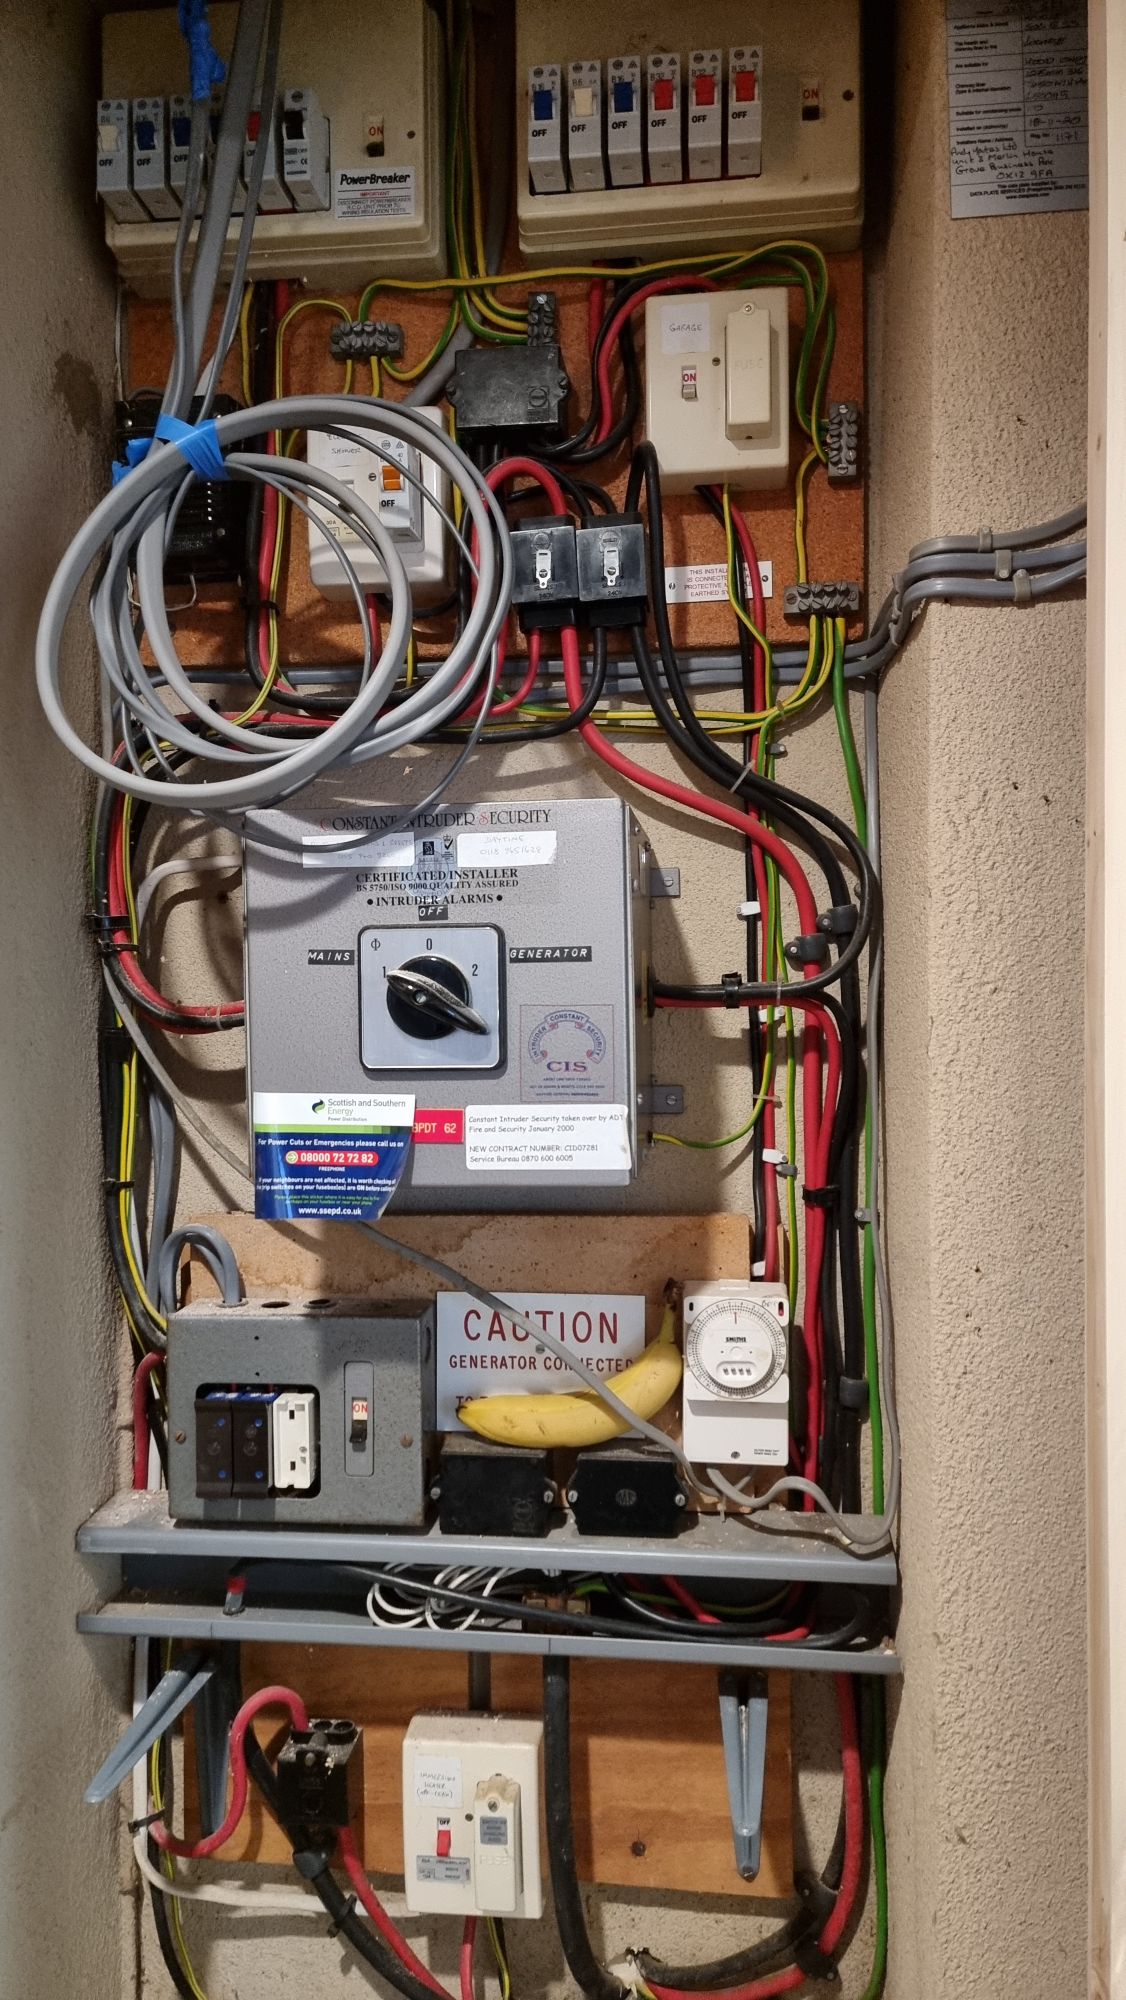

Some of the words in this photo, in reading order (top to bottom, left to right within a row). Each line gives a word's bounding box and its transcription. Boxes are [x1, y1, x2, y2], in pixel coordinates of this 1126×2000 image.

[803, 88, 820, 99] ON
[691, 115, 708, 124] OFF
[732, 111, 748, 120] OFF
[571, 124, 587, 133] OFF
[611, 121, 628, 130] OFF
[651, 119, 667, 128] OFF
[369, 125, 384, 136] ON
[532, 129, 548, 138] OFF
[99, 158, 114, 167] OFF
[136, 158, 152, 167] OFF
[173, 153, 188, 163] OFF
[340, 172, 412, 186] PowerBreaker
[669, 323, 703, 332] GARAGE
[682, 372, 697, 383] ON
[381, 499, 396, 508] OFF
[320, 815, 398, 831] CONSTANT
[403, 811, 476, 829] NTRUDER
[478, 808, 552, 826] SECURITY
[356, 870, 447, 883] CERTIFICATED
[449, 868, 519, 881] INSTALLER
[356, 884, 367, 892] BS
[408, 881, 428, 891] 9000
[430, 880, 472, 891] QUALITY
[473, 879, 519, 889] ASSURED
[376, 895, 440, 906] INTRUDER
[443, 893, 494, 905] ALARMS
[419, 906, 443, 917] OFF
[426, 937, 433, 951] 0
[308, 951, 351, 962] MAINS
[509, 947, 588, 960] GENERATOR
[382, 965, 387, 978] 1
[471, 964, 479, 977] 2
[549, 1013, 585, 1022] CONSTANT
[546, 1060, 589, 1073] CIS
[327, 1098, 357, 1107] Scottish
[358, 1099, 371, 1107] and
[372, 1099, 406, 1107] Southern
[327, 1107, 354, 1116] Energy
[469, 1115, 498, 1123] Constant
[531, 1115, 561, 1124] Security
[598, 1114, 607, 1123] by
[444, 1122, 457, 1134] 62
[469, 1125, 483, 1133] Fire
[498, 1124, 526, 1134] Security
[528, 1124, 555, 1134] January
[557, 1124, 575, 1132] 2000
[268, 1138, 288, 1146] Power
[313, 1139, 355, 1148] Emergencies
[355, 1139, 377, 1148] please
[469, 1145, 487, 1153] NEW
[488, 1145, 528, 1153] CONTRACT
[300, 1152, 331, 1162] 08000
[333, 1152, 345, 1163] 72
[347, 1152, 359, 1163] 72
[361, 1152, 374, 1164] 82
[470, 1155, 495, 1163] Service
[496, 1154, 520, 1162] Bureau
[521, 1154, 539, 1162] 0870
[540, 1154, 554, 1162] 600
[556, 1154, 574, 1162] 6005
[298, 1206, 362, 1216] www.ssepd.co.uk
[463, 1309, 618, 1345] CAUTION
[449, 1354, 537, 1371] GENERATOR
[544, 1356, 634, 1374] CONECTED
[352, 1403, 368, 1413] ON
